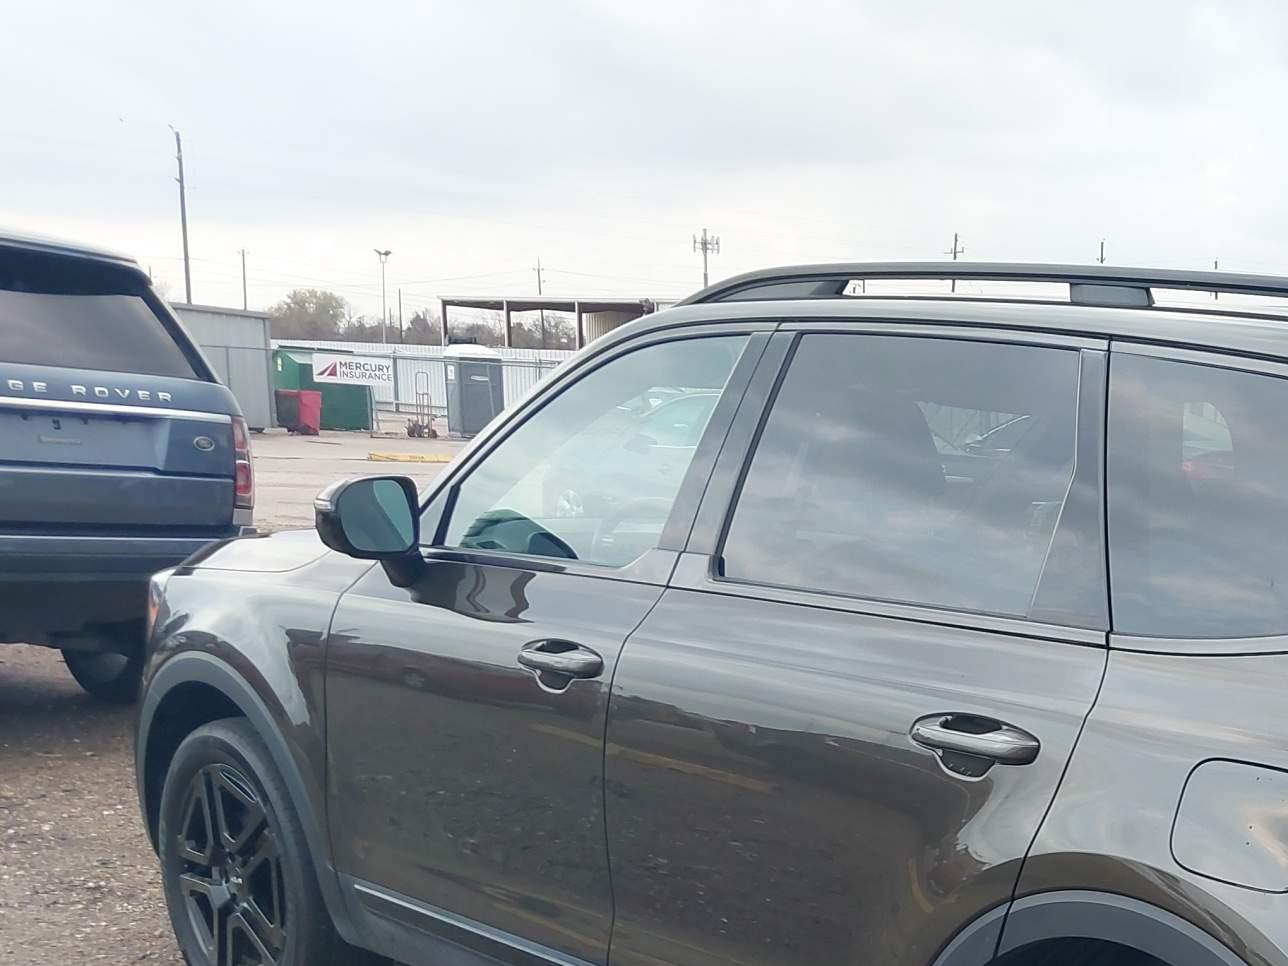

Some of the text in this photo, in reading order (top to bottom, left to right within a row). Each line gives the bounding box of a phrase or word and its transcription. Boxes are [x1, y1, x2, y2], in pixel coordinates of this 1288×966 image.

[339, 360, 391, 373] MERCURY
[339, 370, 393, 382] INSURANCE
[71, 384, 173, 402] ROVER
